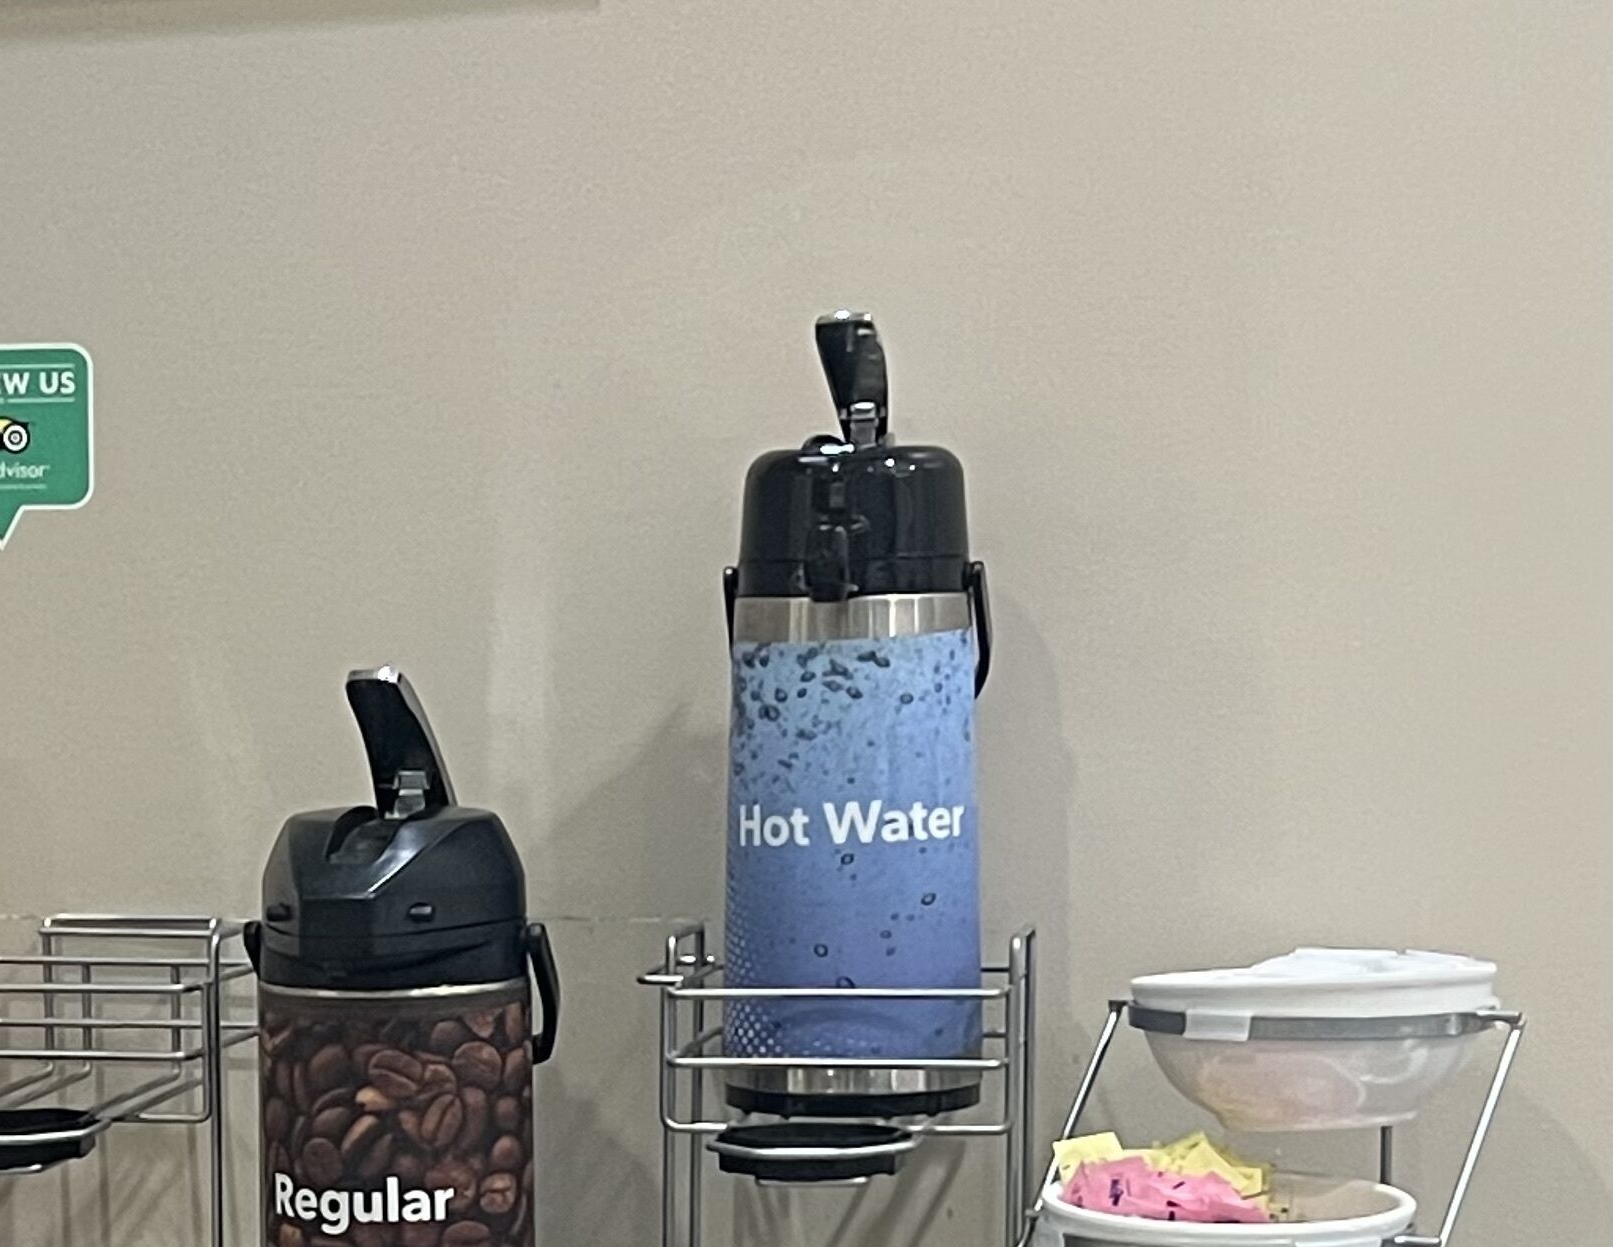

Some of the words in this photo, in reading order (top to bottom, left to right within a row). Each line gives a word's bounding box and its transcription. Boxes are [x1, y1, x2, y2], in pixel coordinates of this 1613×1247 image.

[39, 371, 76, 394] US
[739, 804, 810, 847] Hot
[822, 799, 965, 845] Water
[274, 1172, 455, 1235] Regular
